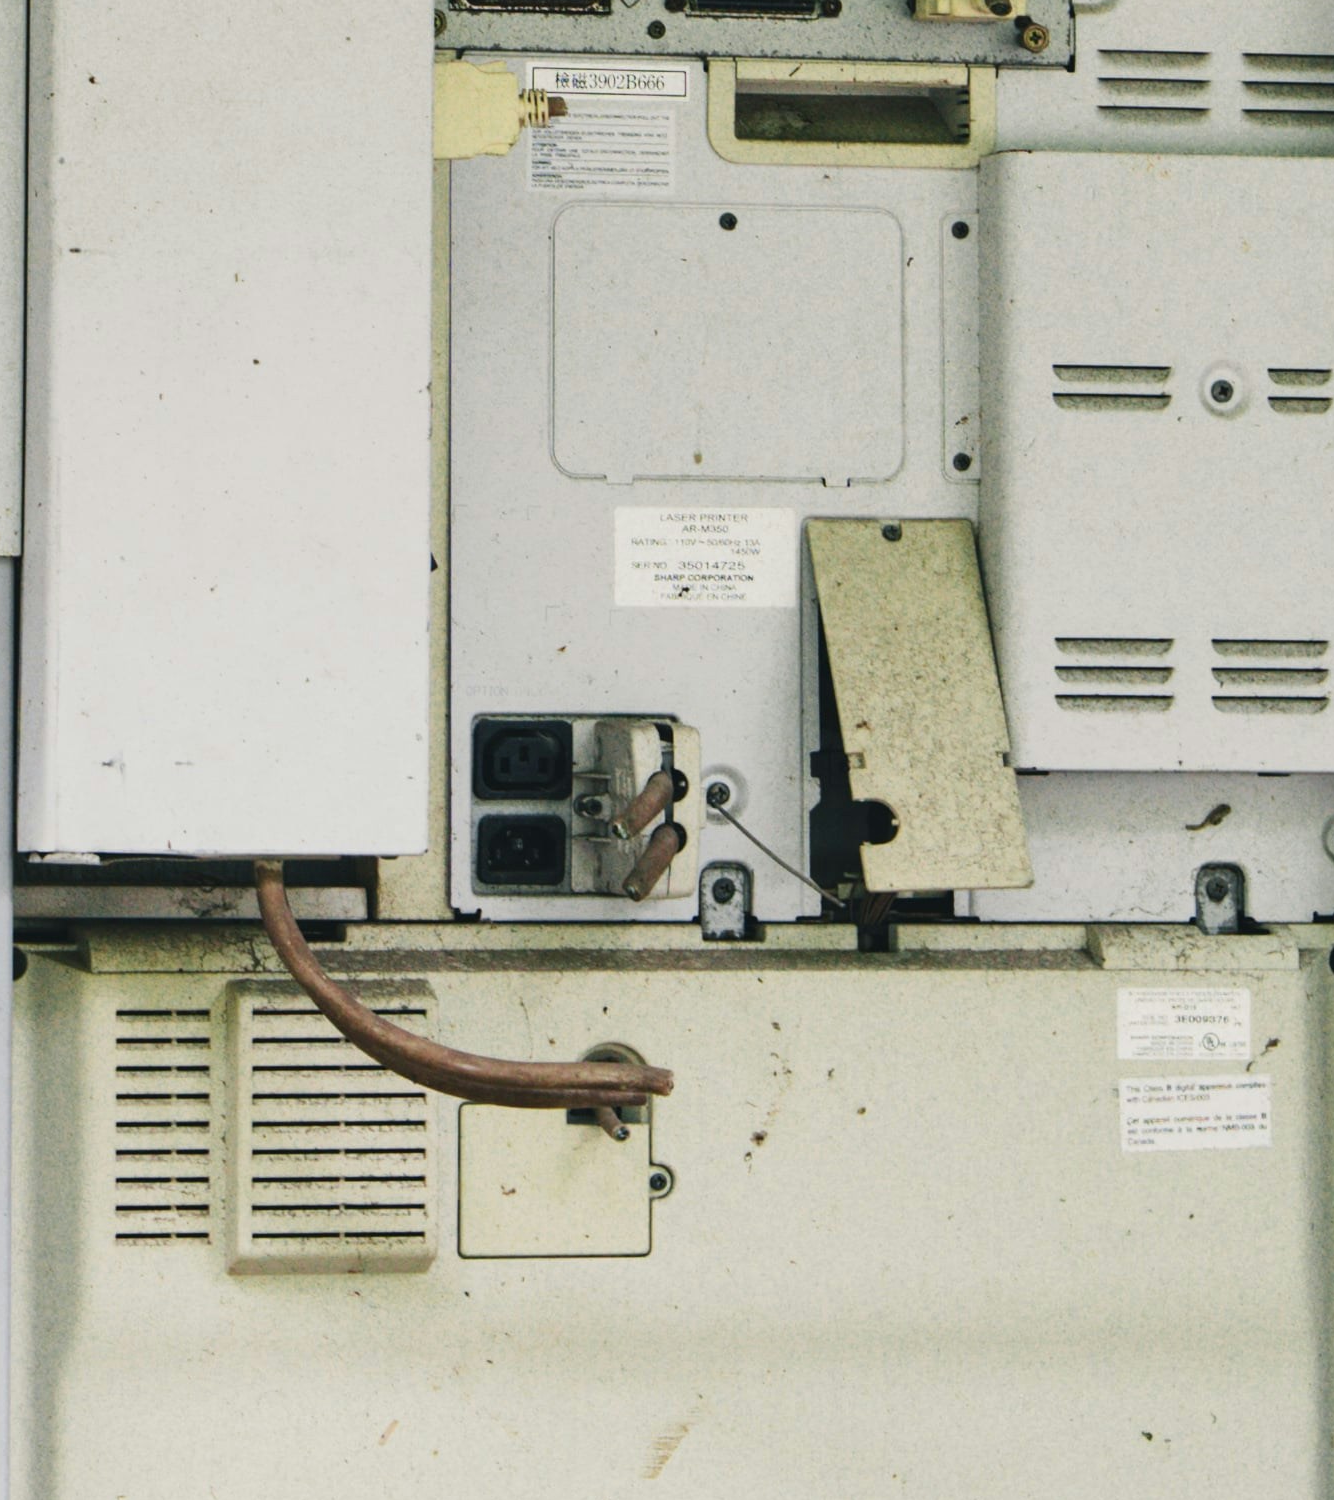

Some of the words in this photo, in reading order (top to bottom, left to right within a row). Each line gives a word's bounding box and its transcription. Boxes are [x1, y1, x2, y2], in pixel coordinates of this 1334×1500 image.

[659, 513, 696, 522] LASER
[699, 513, 748, 523] PRINTER
[681, 524, 729, 534] AR-M350
[677, 561, 746, 570] 35014725
[654, 574, 685, 582] SHARP
[687, 574, 754, 582] CORPORATION
[699, 584, 709, 592] IN
[710, 584, 737, 592] CHINA
[706, 593, 718, 601] EN
[720, 593, 747, 601] CHINE
[465, 685, 509, 697] OPTION
[1143, 1084, 1163, 1092] Class
[1175, 1083, 1195, 1093] digital
[1198, 1082, 1232, 1092] apparatus
[1235, 1081, 1266, 1091] complies
[1142, 1095, 1174, 1103] Canadian
[1143, 1115, 1170, 1125] appareil
[1235, 1113, 1257, 1121] classe
